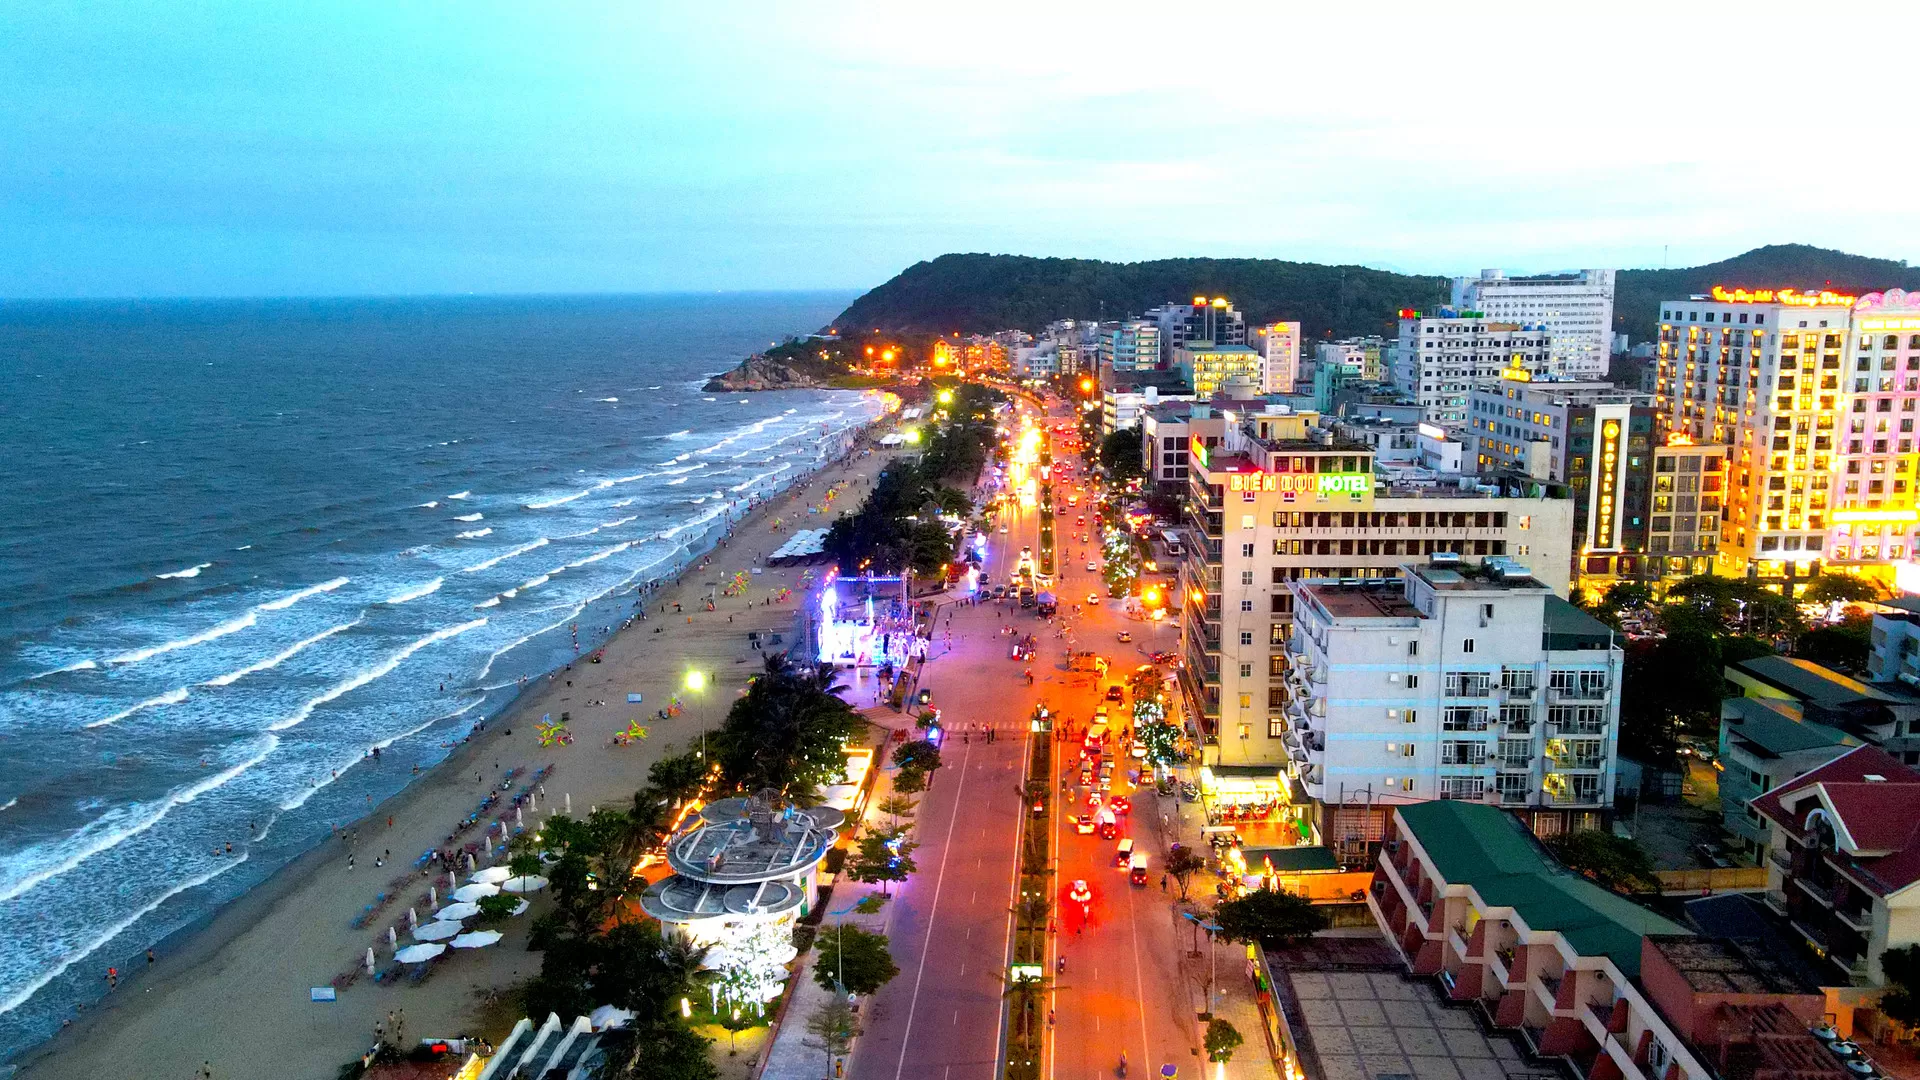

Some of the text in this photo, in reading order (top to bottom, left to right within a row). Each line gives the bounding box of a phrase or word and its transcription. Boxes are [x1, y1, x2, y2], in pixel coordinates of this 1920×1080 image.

[1318, 475, 1368, 491] HOTEL
[1600, 442, 1615, 544] ROYAL HOTEL
